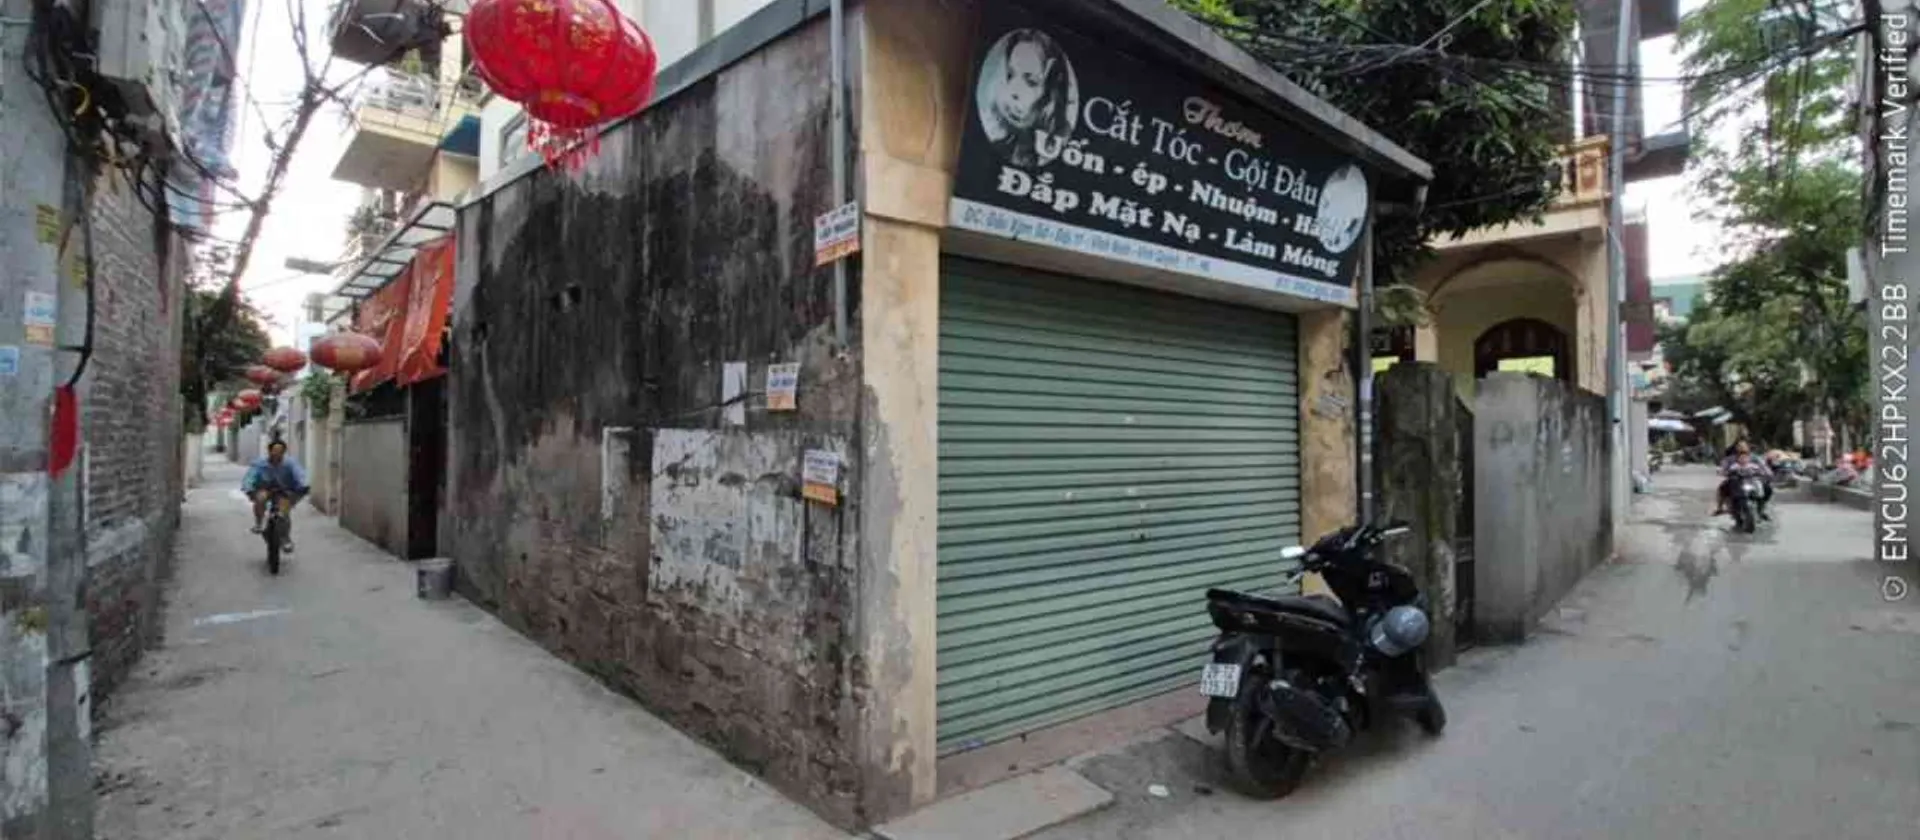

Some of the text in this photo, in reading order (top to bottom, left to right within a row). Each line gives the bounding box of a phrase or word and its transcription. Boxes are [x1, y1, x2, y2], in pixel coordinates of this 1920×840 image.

[1035, 129, 1105, 174] Uốn
[1131, 162, 1168, 195] ép
[1189, 180, 1278, 226] Nhuộm
[1083, 97, 1143, 146] Cắt
[1151, 117, 1202, 165] Tóc
[1224, 149, 1271, 192] Gội
[997, 166, 1080, 213] Đắp
[1089, 191, 1154, 229] Mặt
[1161, 211, 1201, 243] Nạ
[1224, 228, 1276, 259] Làm
[1281, 243, 1341, 278] Móng
